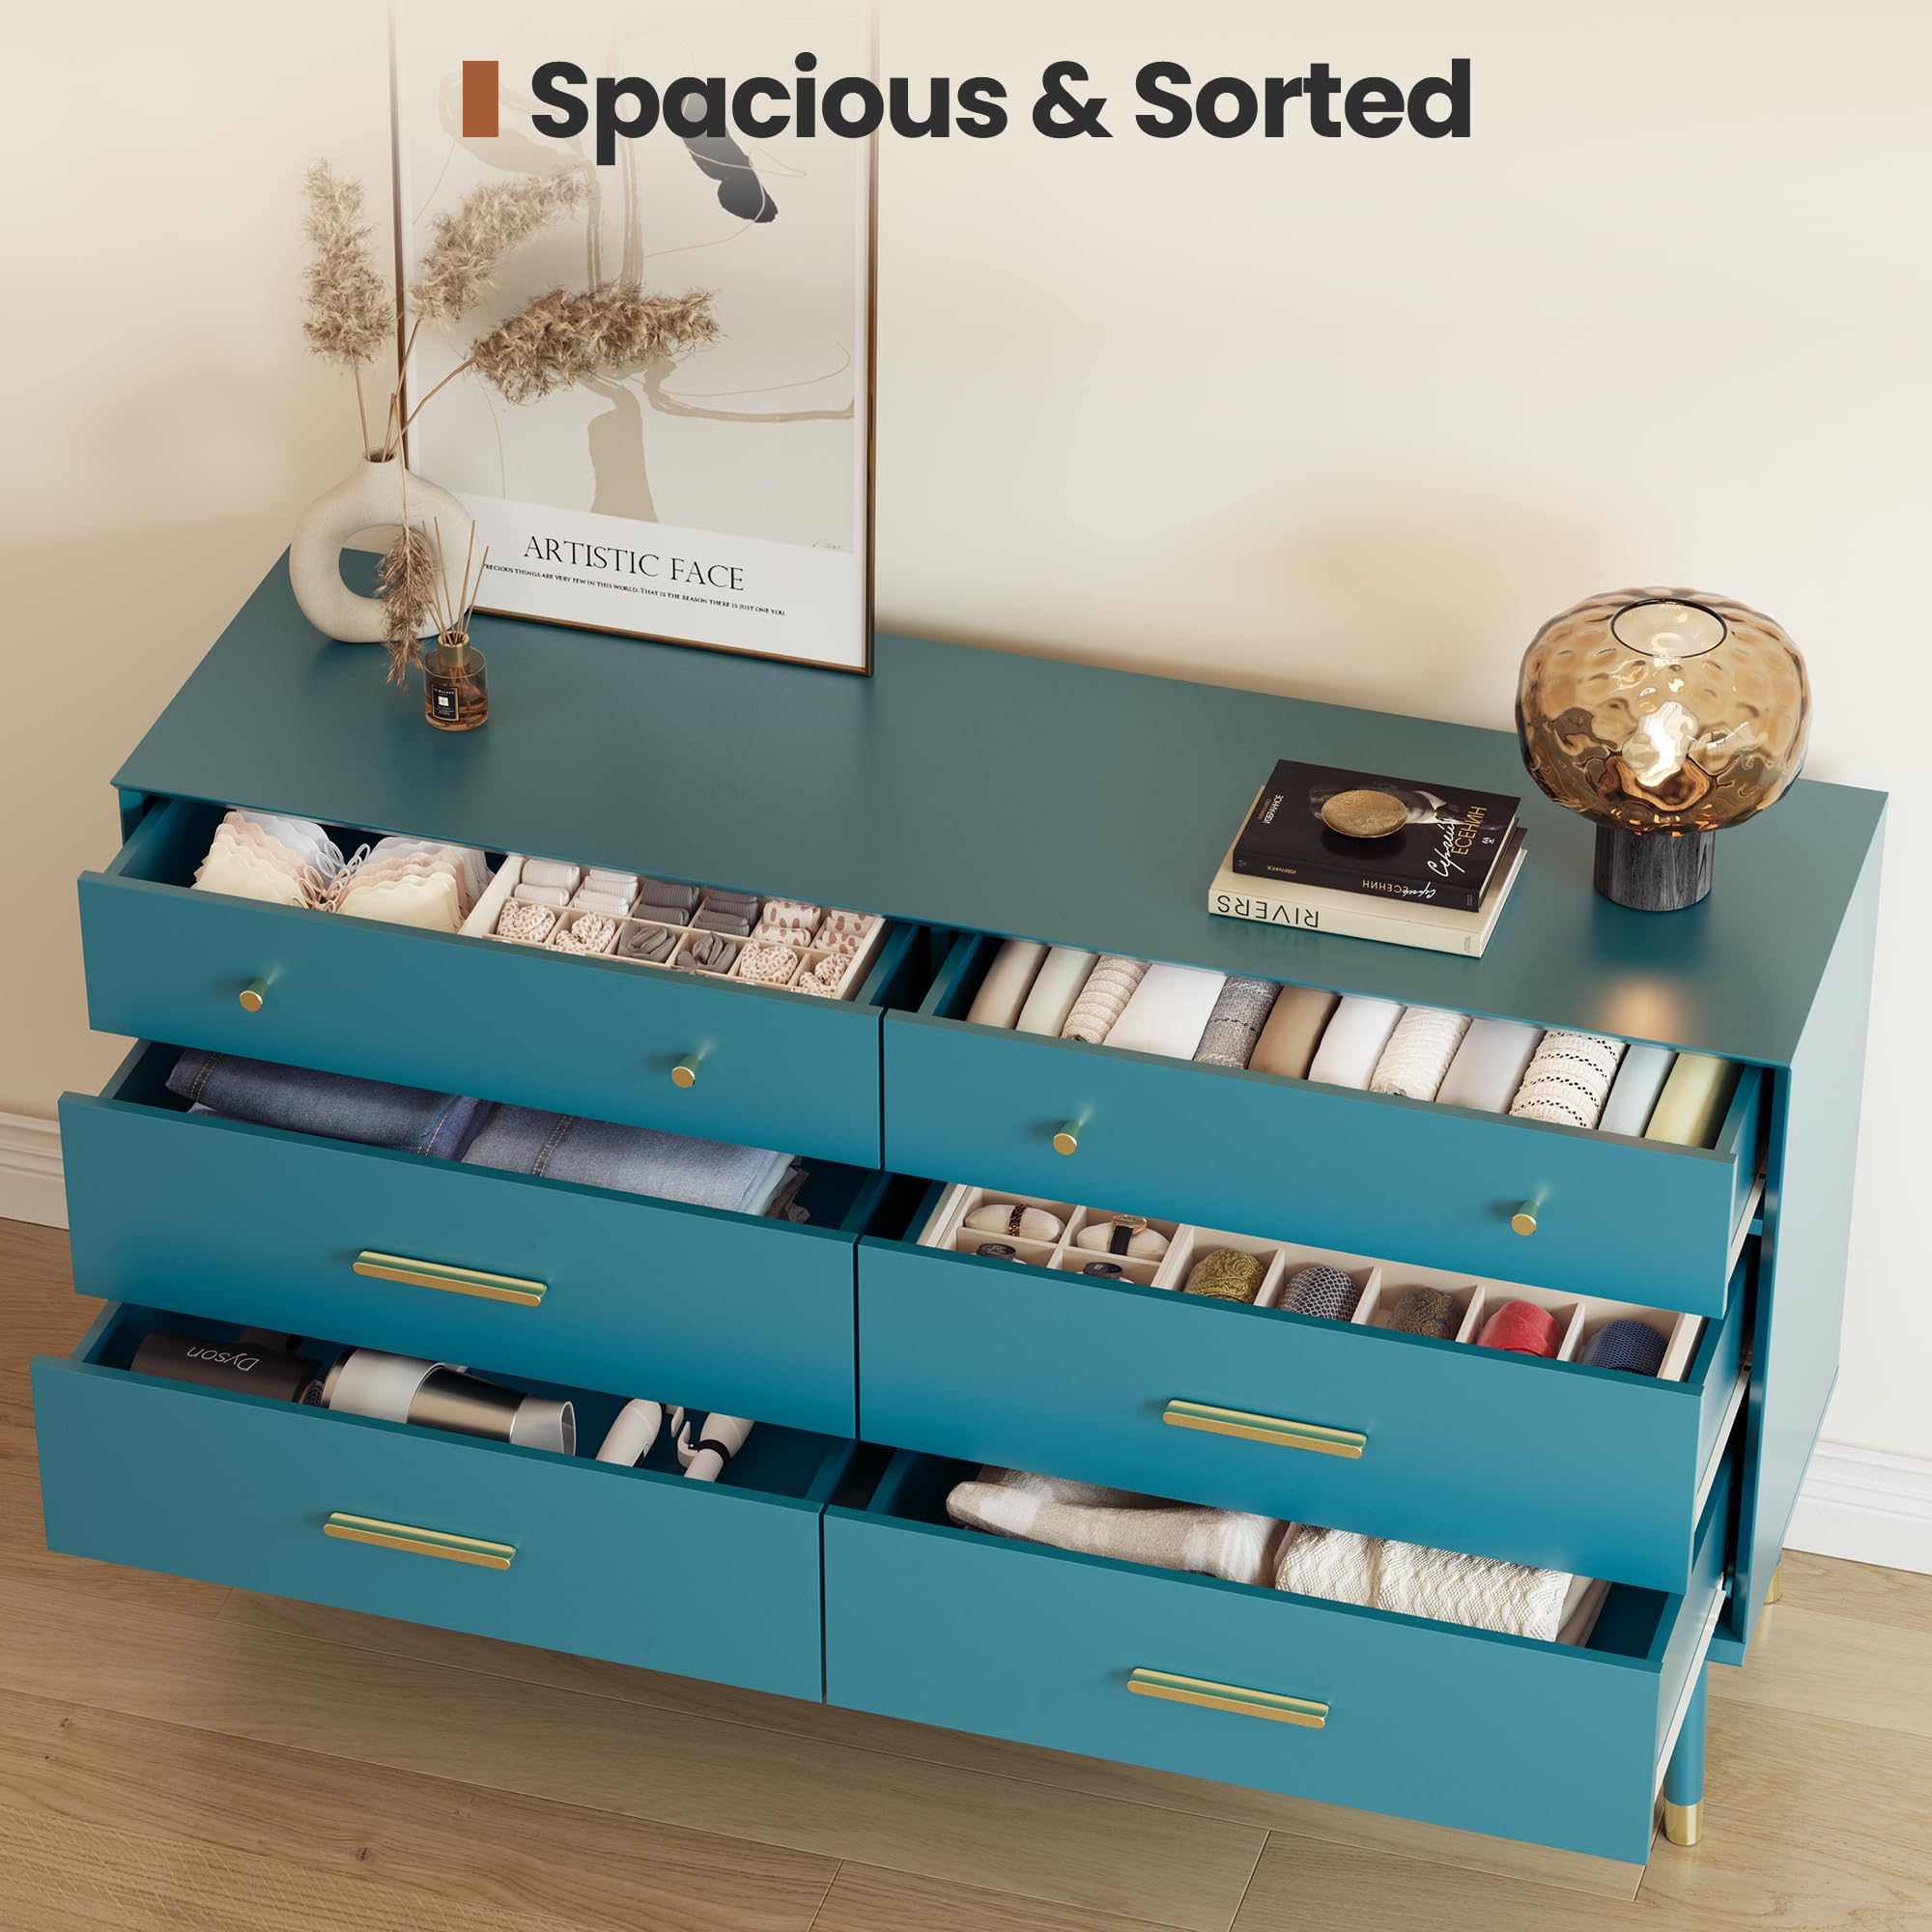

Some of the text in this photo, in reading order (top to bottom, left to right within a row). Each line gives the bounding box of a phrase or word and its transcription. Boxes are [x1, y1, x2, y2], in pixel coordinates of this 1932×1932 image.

[524, 535, 744, 591] ARTISTIC FACE
[515, 568, 540, 578] THINGS
[612, 583, 639, 593] WORLD.
[639, 587, 659, 596] THAT
[682, 594, 708, 604] REASON
[709, 599, 730, 608] THERE
[1450, 805, 1488, 856] ЕСЕНИН
[1362, 879, 1408, 895] ЕСЕНИН
[1217, 895, 1319, 927] RIVERS
[186, 1346, 261, 1372] Dyson
